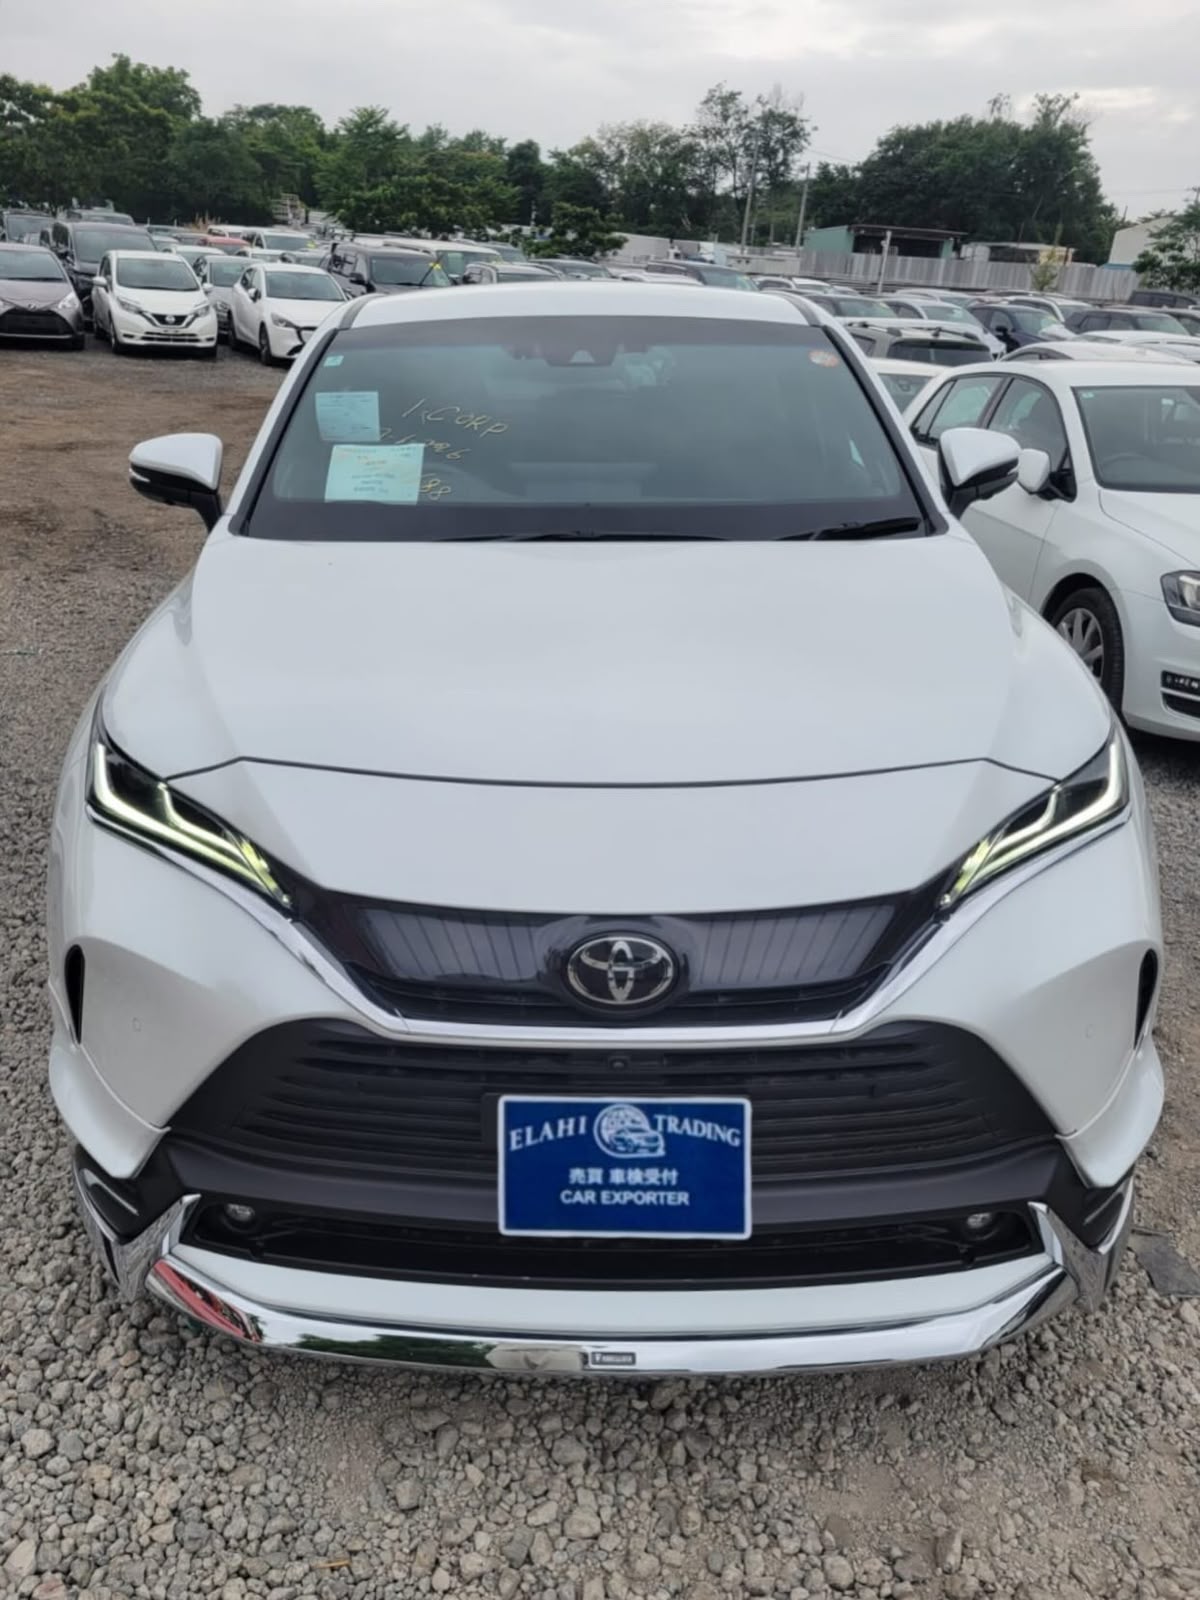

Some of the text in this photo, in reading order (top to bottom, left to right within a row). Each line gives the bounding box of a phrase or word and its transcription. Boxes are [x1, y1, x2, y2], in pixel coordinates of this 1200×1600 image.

[509, 1114, 741, 1151] ELAHI TRADING
[609, 1167, 678, 1186] 車検受付
[560, 1190, 690, 1206] CAR EXPORTER
